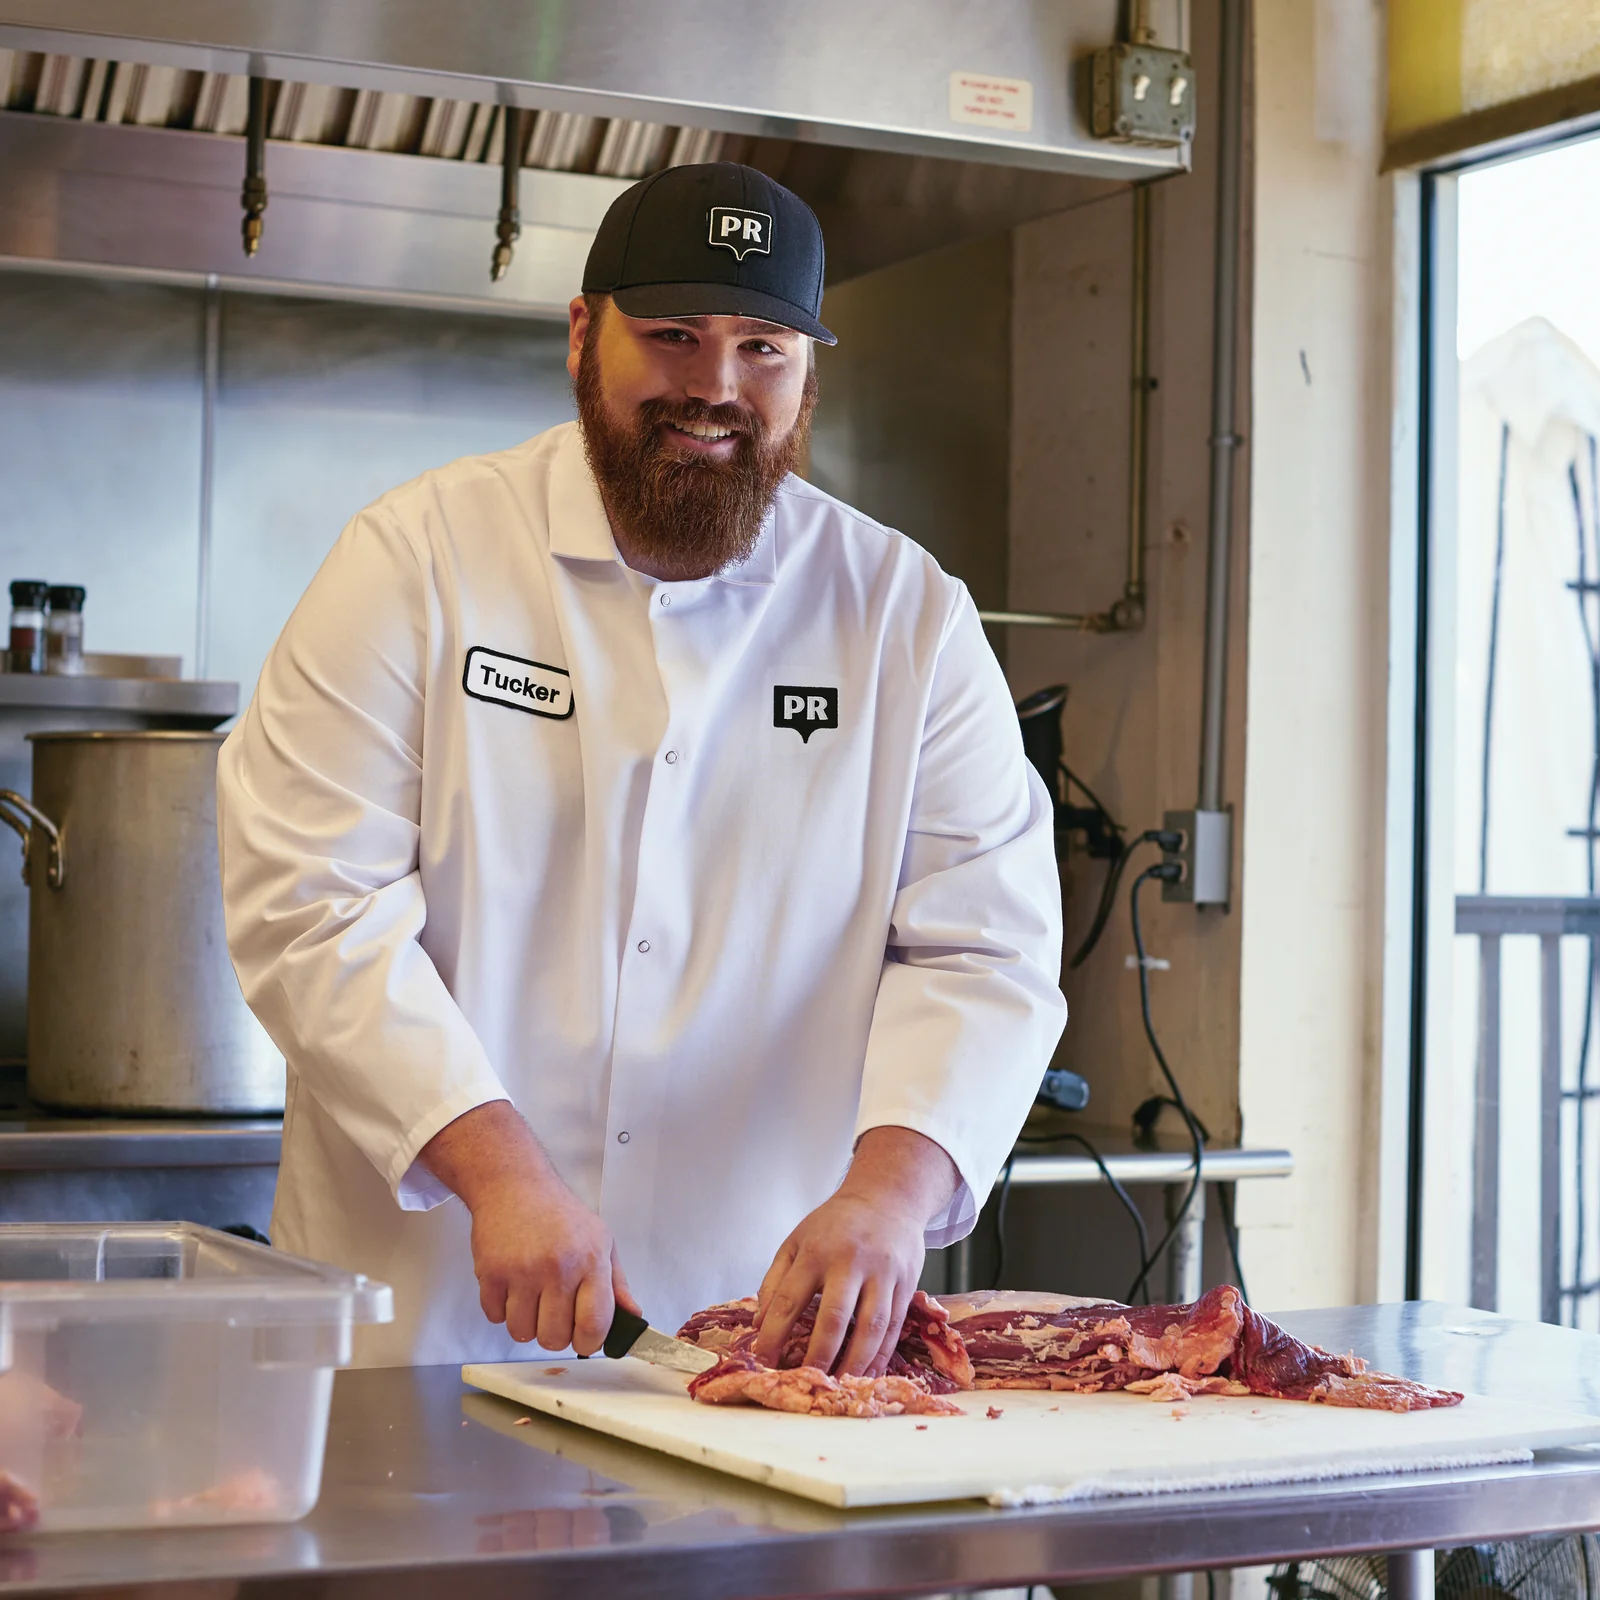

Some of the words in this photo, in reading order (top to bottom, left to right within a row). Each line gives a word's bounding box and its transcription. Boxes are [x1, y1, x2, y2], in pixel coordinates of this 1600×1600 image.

[721, 215, 762, 243] PR
[480, 664, 560, 703] Tucker
[783, 695, 829, 720] PR
